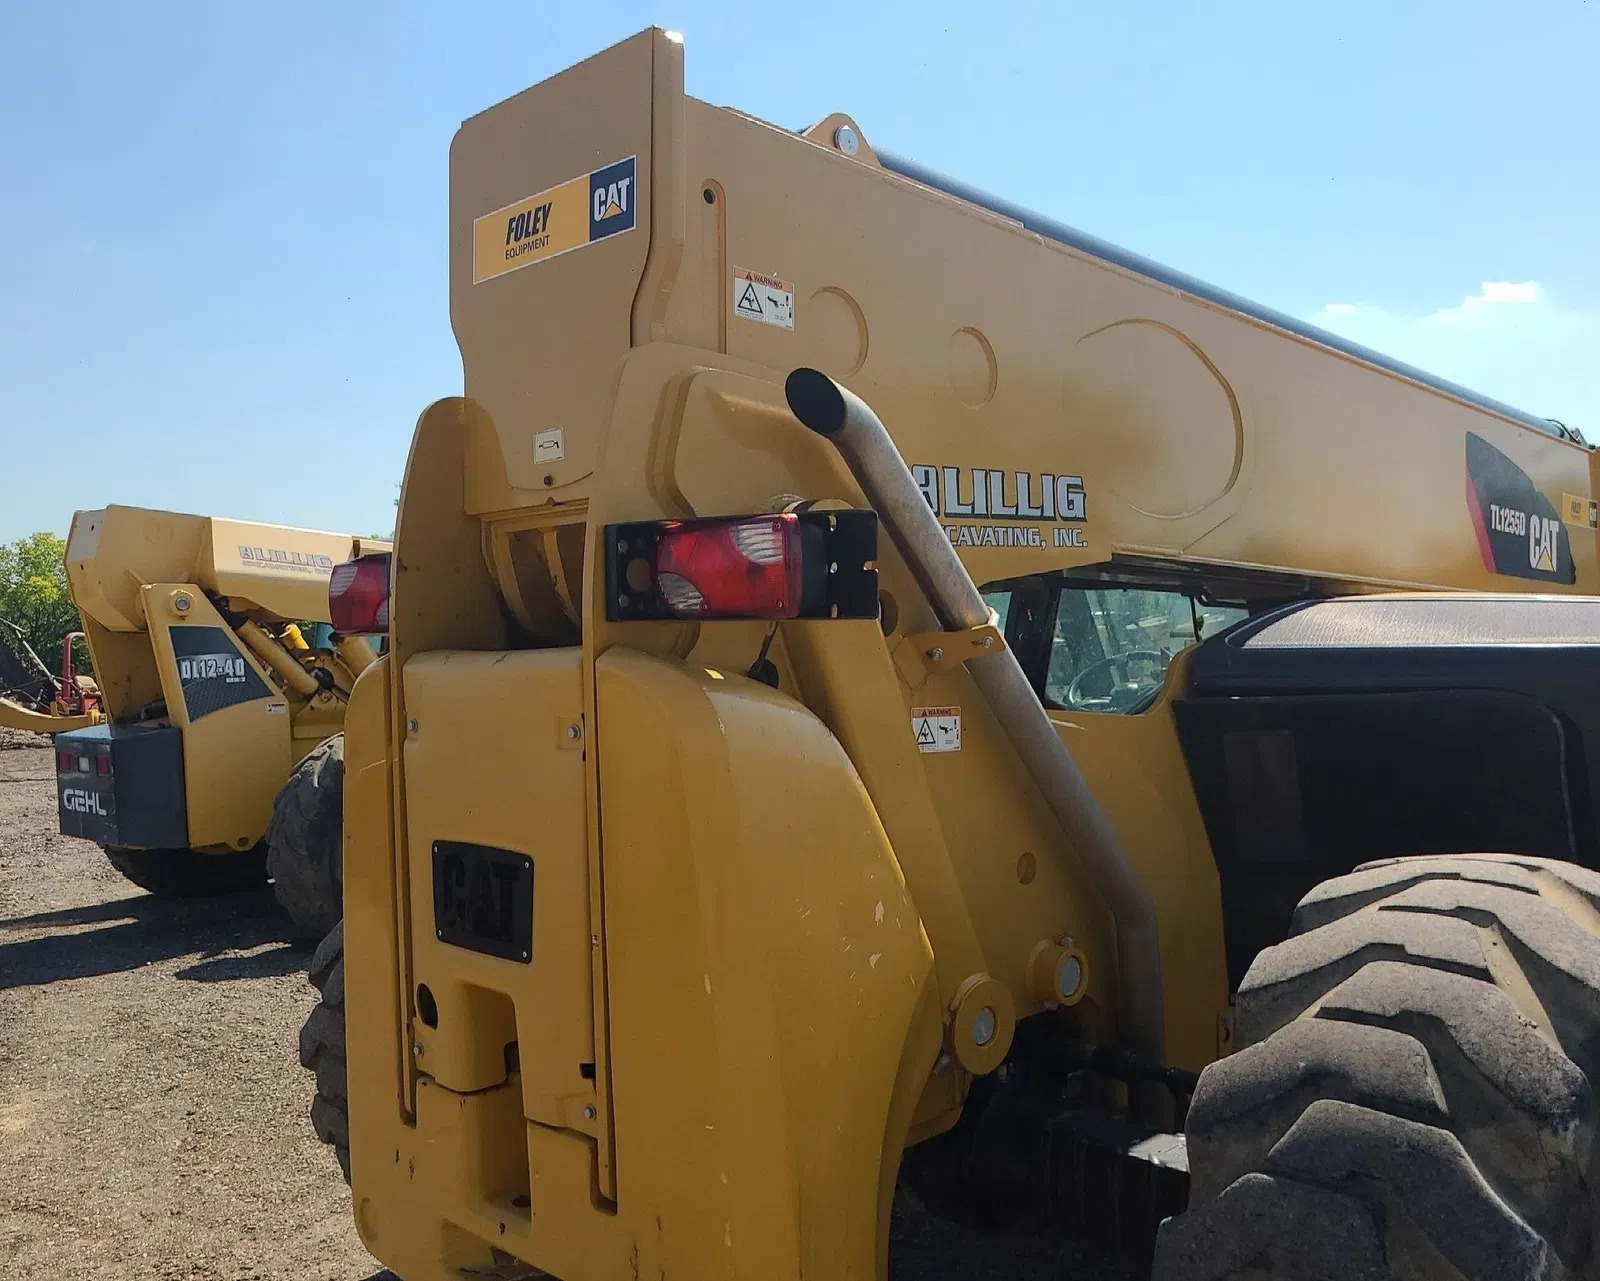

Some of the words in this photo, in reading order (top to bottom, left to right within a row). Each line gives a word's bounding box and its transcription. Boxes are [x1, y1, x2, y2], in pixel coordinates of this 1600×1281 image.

[594, 177, 631, 222] CAT
[505, 202, 553, 246] FOLEY
[505, 234, 551, 260] EQUIPMENT
[753, 273, 783, 289] WARNING
[1490, 504, 1526, 537] TL1255D
[943, 524, 1047, 550] CAVATING,
[1053, 527, 1089, 549] INC.
[1529, 514, 1560, 572] CAT
[63, 788, 108, 816] GEHL
